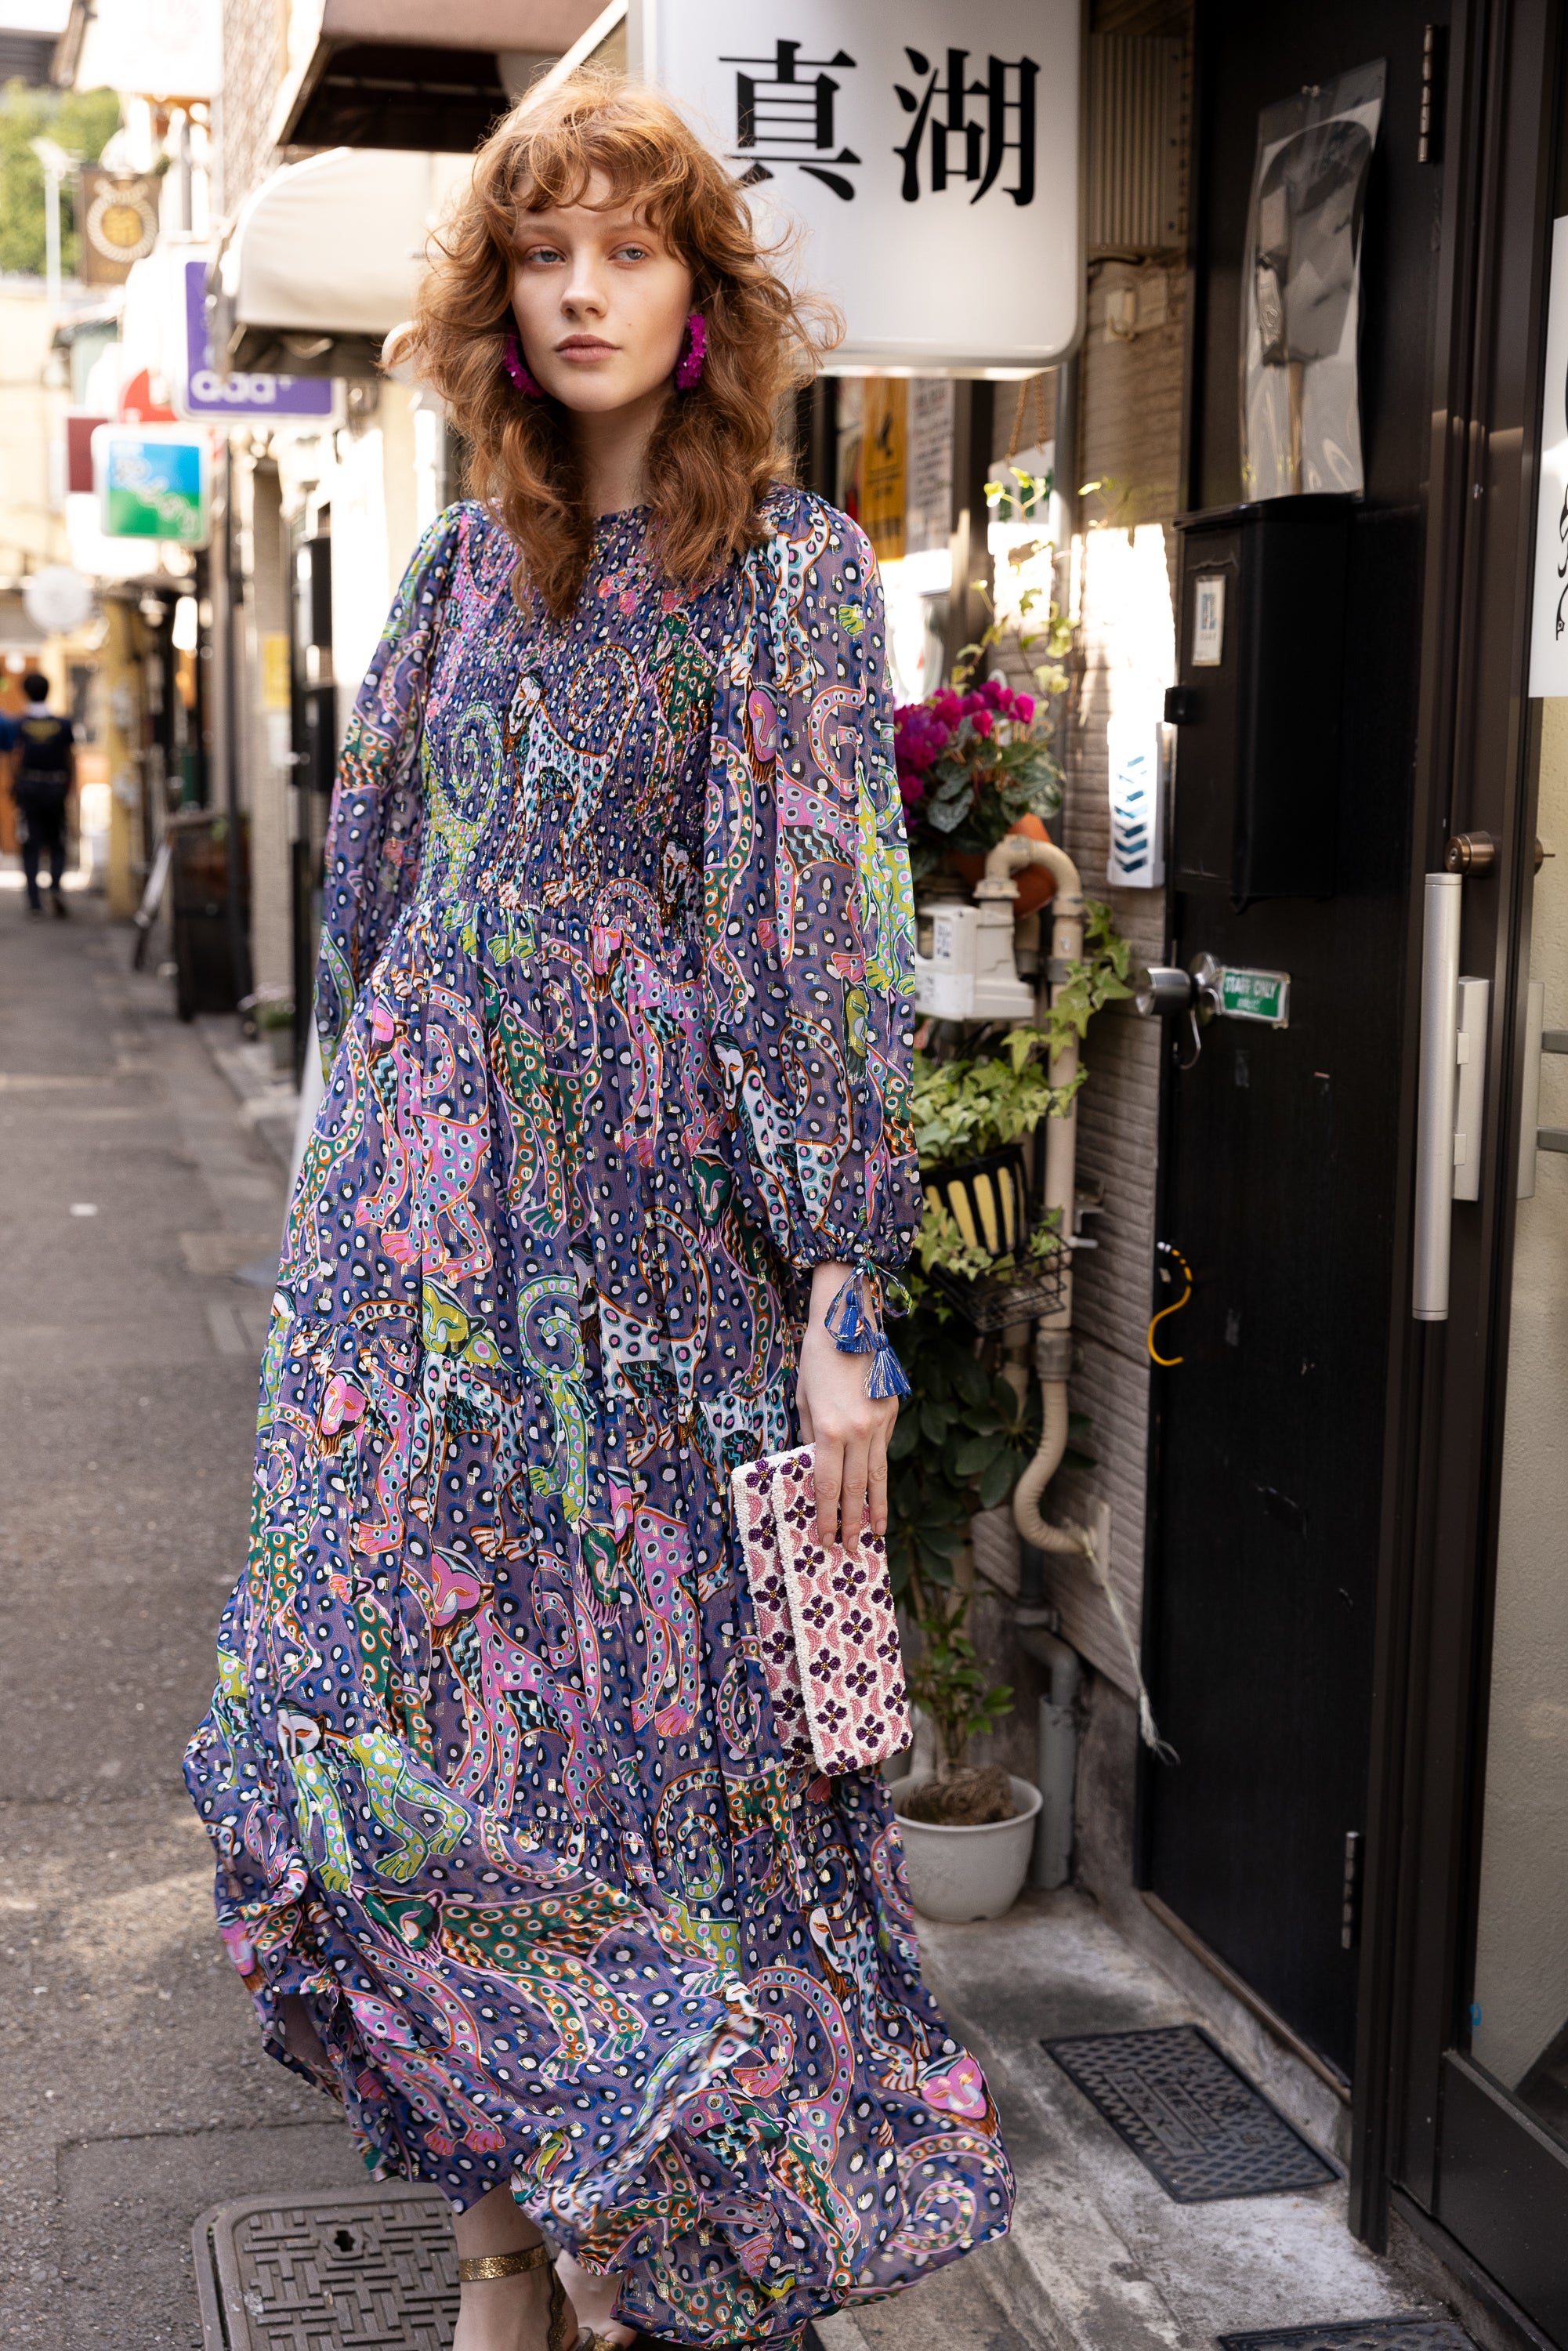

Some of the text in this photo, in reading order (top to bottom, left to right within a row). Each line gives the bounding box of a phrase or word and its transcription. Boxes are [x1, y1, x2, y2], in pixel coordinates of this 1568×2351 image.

[719, 38, 1041, 206] 真湖
[1225, 976, 1277, 999] STAFF ONLY
